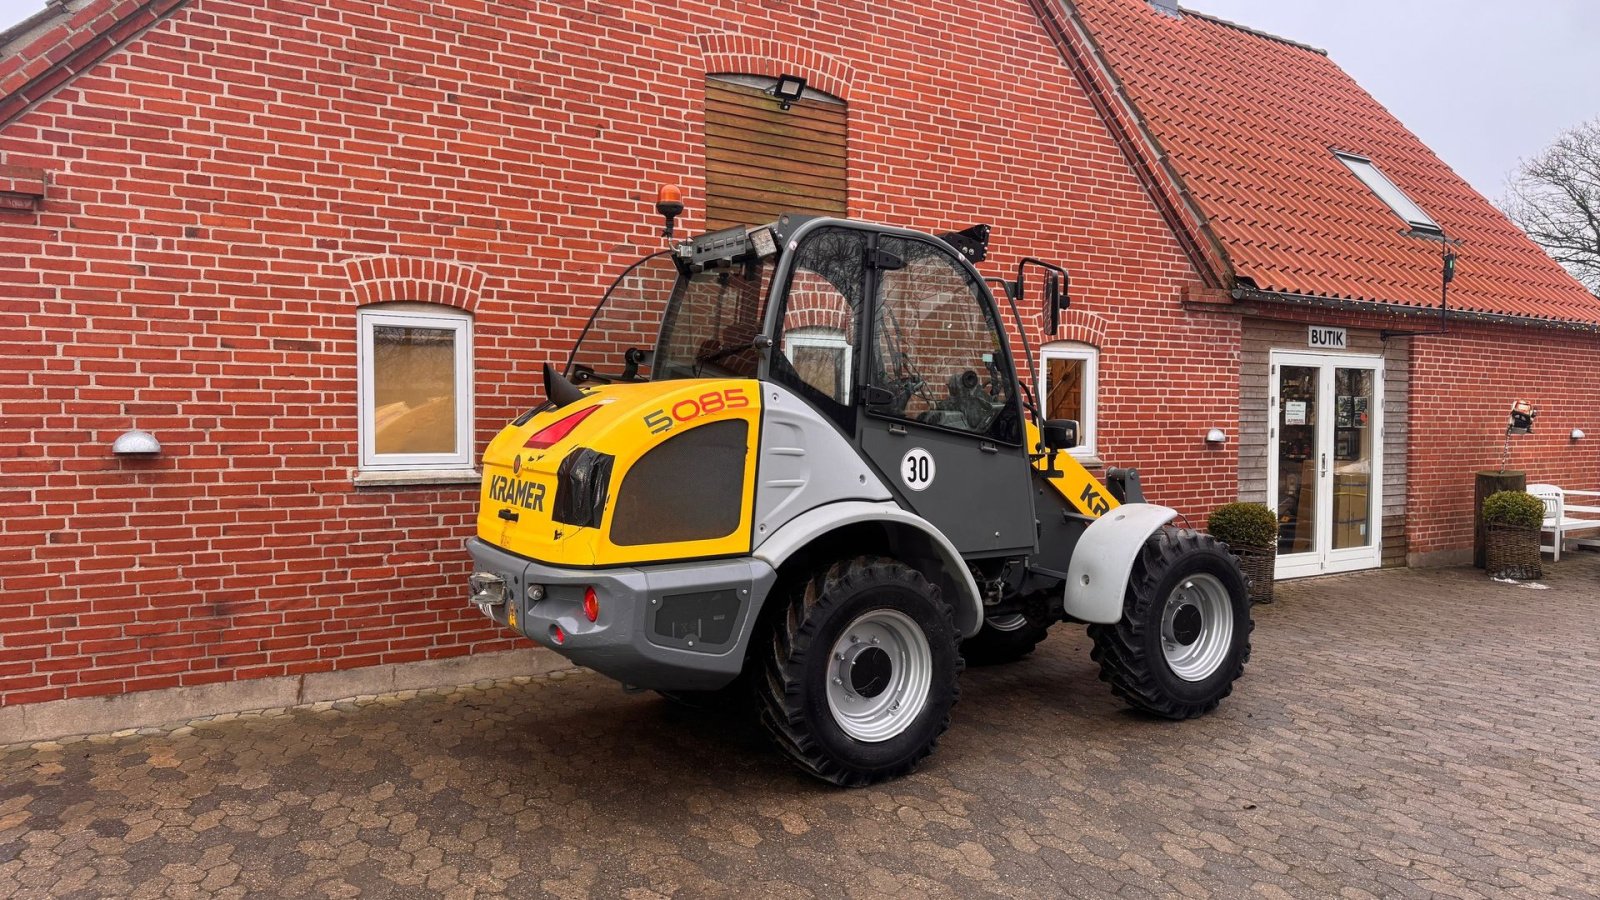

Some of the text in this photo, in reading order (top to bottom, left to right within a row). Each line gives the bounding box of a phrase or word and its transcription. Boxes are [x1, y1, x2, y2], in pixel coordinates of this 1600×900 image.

[1311, 329, 1343, 346] BUTIK
[643, 388, 749, 435] 5085
[907, 455, 929, 482] 30
[489, 474, 546, 512] KRAMER
